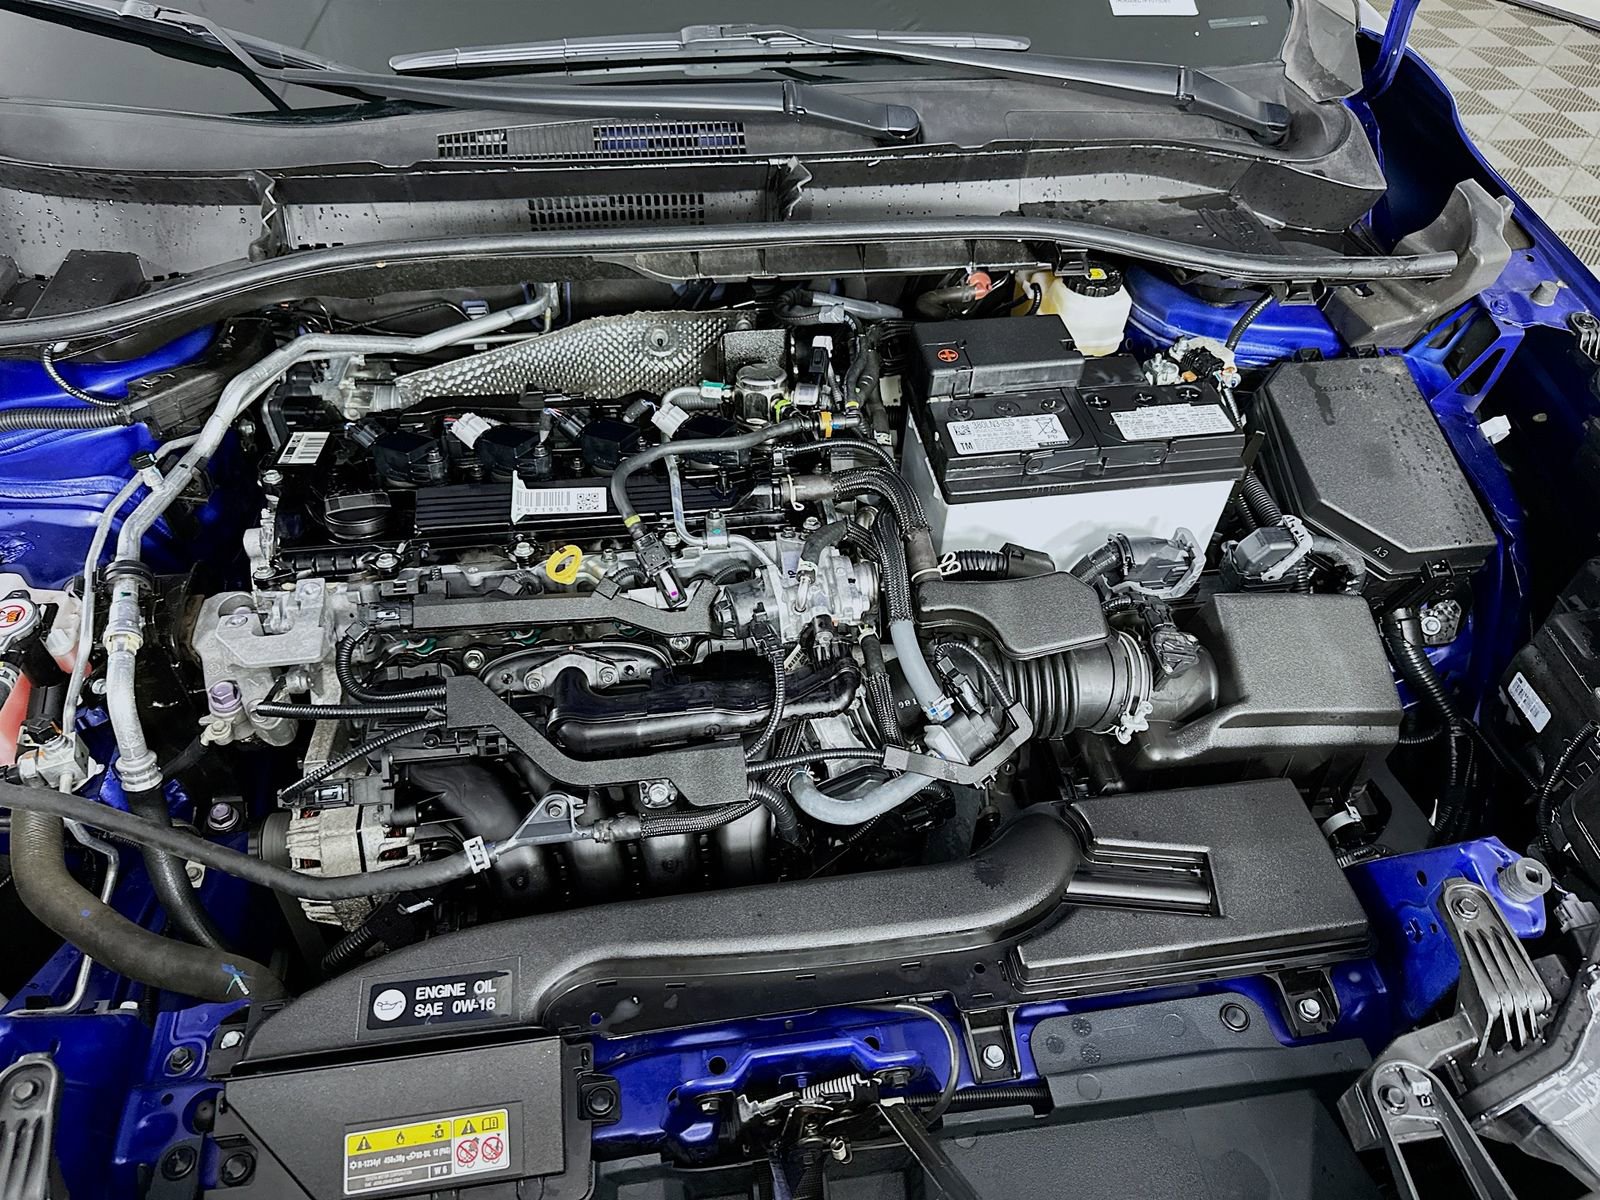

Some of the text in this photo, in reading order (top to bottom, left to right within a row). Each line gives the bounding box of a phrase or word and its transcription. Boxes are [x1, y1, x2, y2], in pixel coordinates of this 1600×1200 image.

[960, 442, 973, 451] TM
[1372, 546, 1389, 558] A3
[415, 979, 496, 1000] ENGINE OIL
[414, 997, 496, 1018] SAE 0W-16
